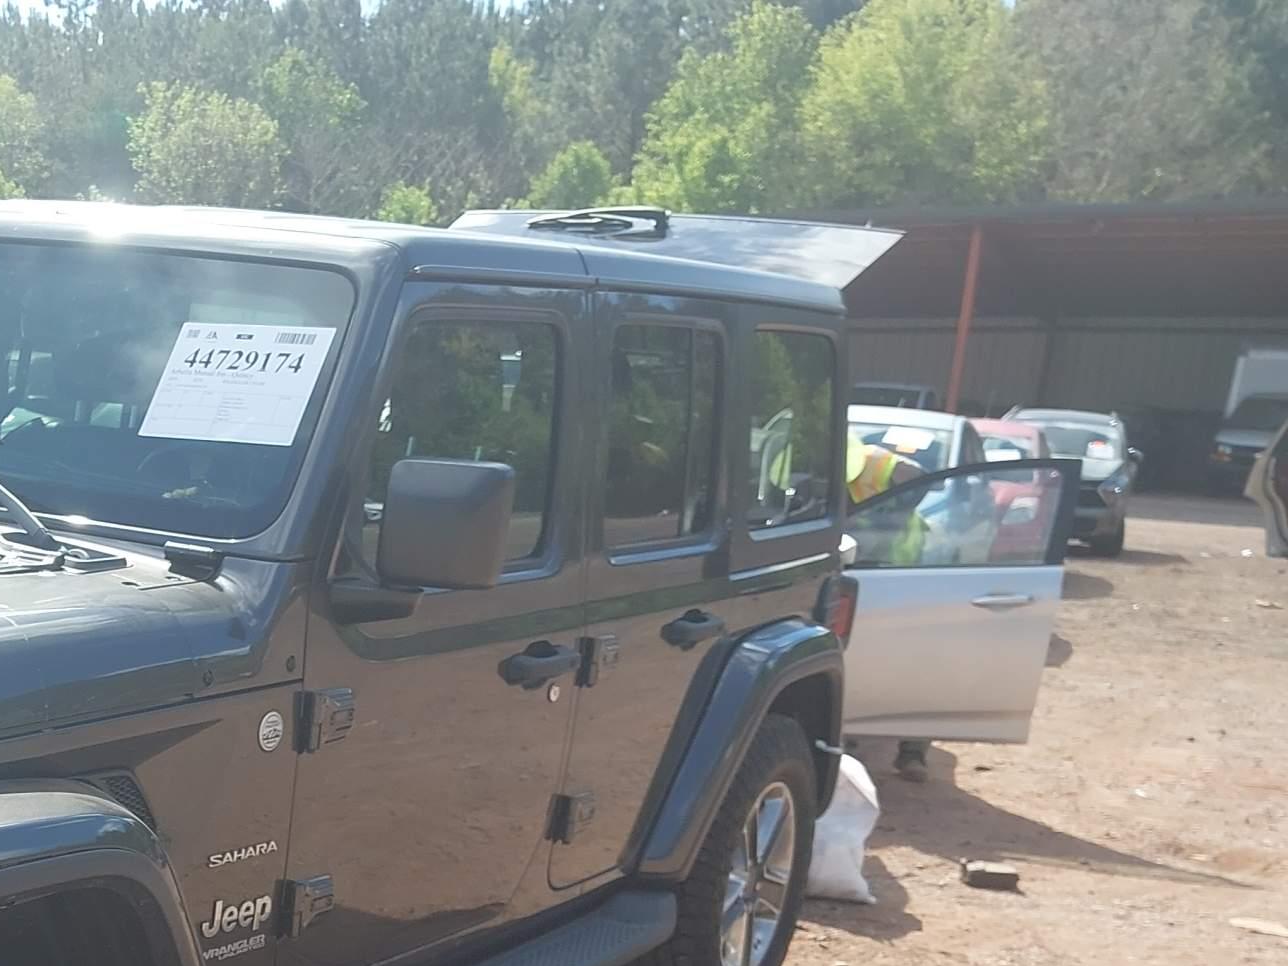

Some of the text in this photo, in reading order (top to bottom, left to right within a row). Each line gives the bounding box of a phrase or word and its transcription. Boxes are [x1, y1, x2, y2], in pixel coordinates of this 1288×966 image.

[184, 348, 305, 374] 44729174
[208, 840, 278, 868] SAHARA
[201, 895, 272, 938] Jeep
[203, 934, 265, 960] WRANGLER
